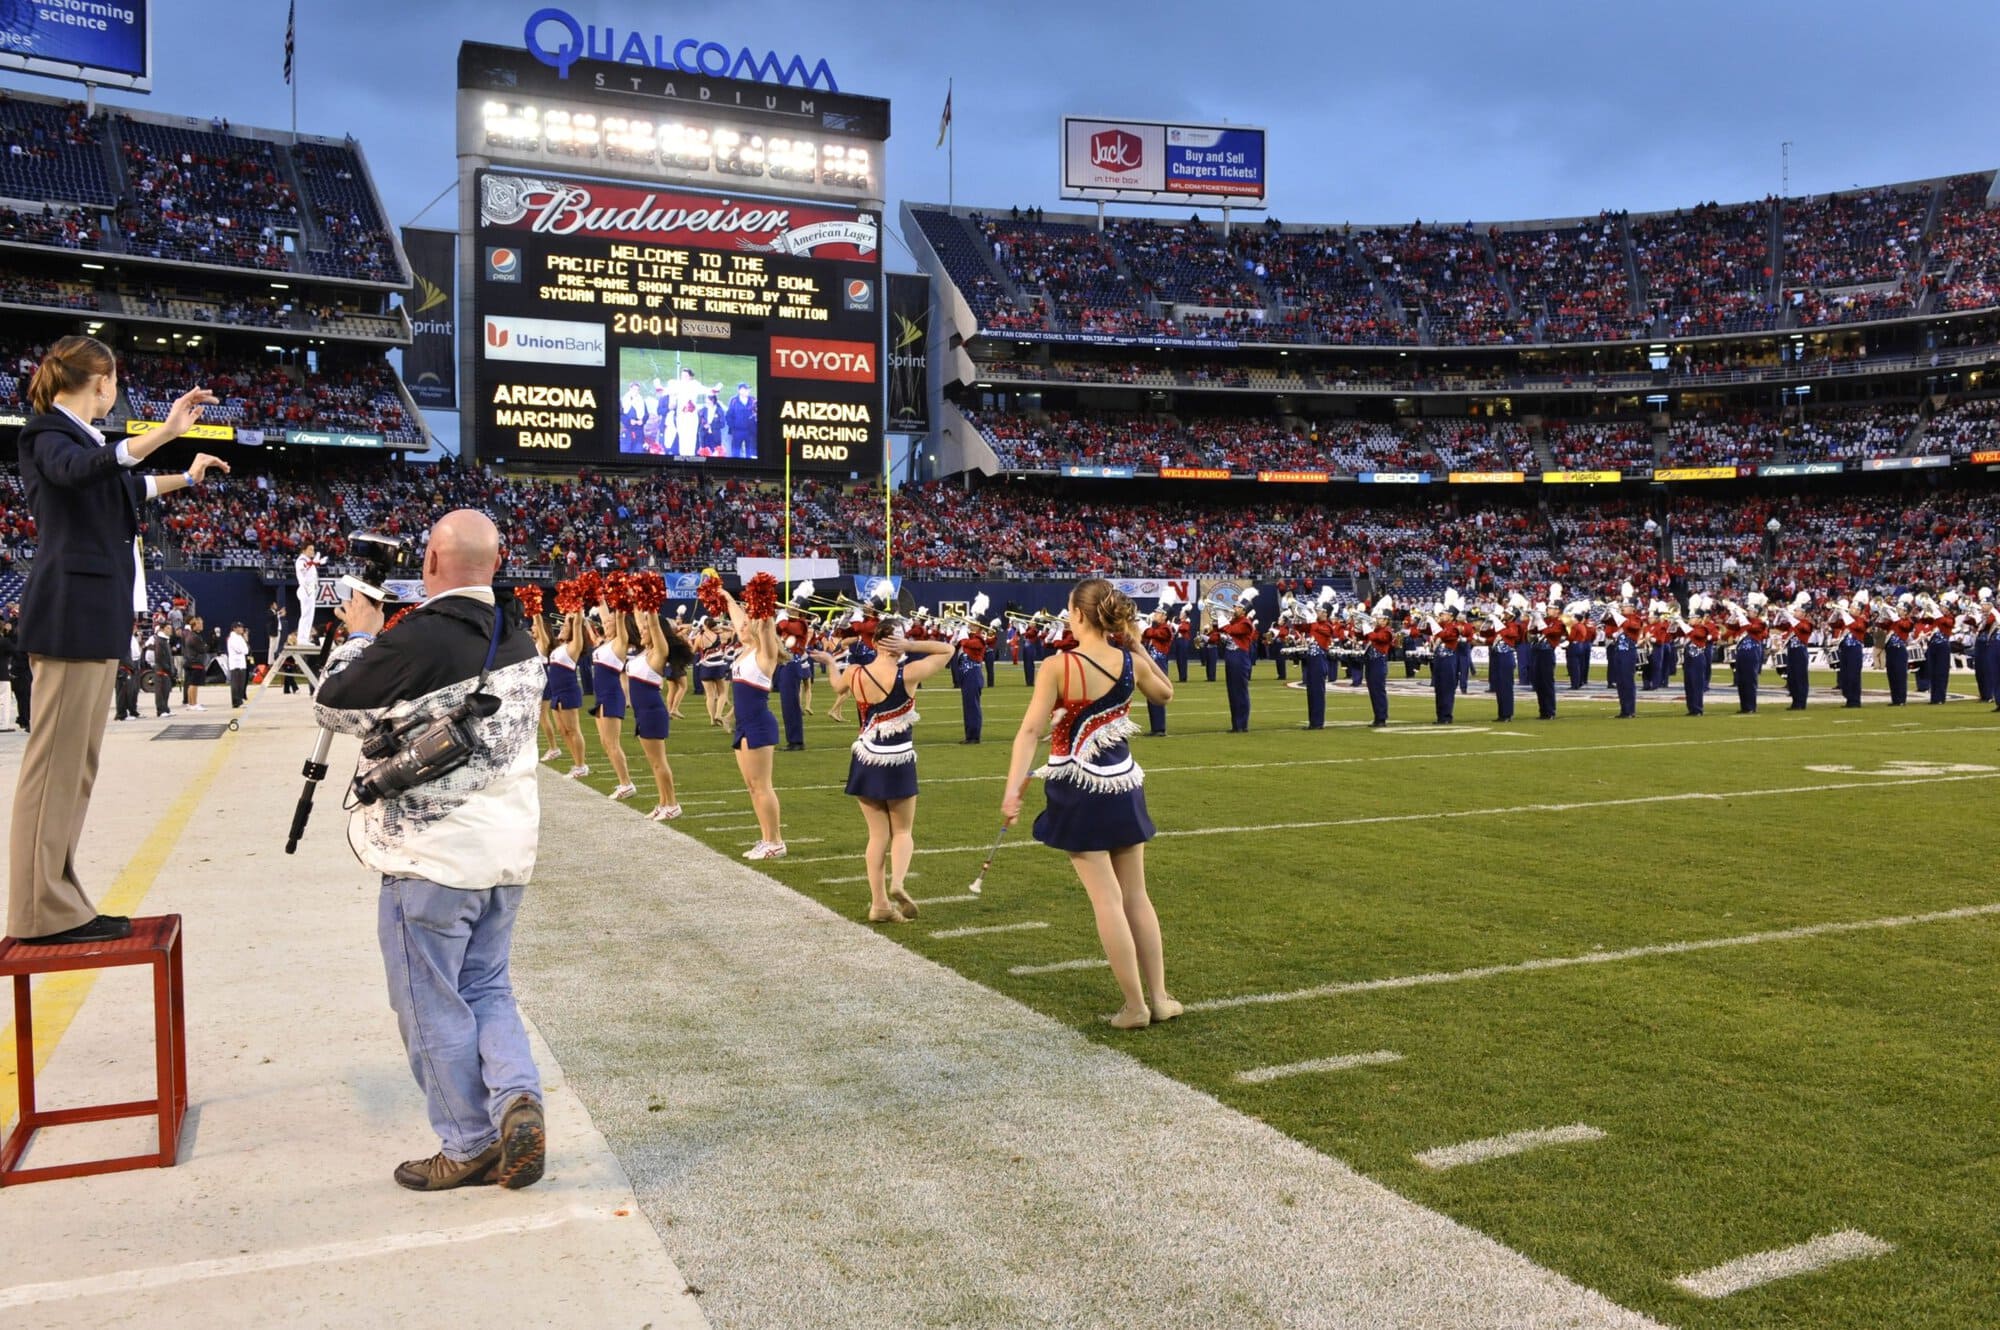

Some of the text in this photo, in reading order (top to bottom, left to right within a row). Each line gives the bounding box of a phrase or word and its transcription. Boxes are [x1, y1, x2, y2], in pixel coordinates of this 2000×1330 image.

[40, 9, 108, 31] science
[524, 7, 839, 92] QUALCOMM
[594, 72, 815, 114] STADIUM
[1092, 136, 1141, 166] Jack
[1186, 150, 1244, 164] Buy and Sell
[1095, 174, 1139, 185] in the box
[1173, 162, 1257, 179] Chargers Tickets!
[518, 188, 790, 235] Budweiser
[793, 228, 874, 248] American Lager
[611, 245, 764, 271] WELCOME TO THE
[493, 273, 515, 281] pepsi
[547, 255, 819, 292] PACIFIC LIFE HOLIDAY BOWL
[557, 274, 812, 306] PRE-GAME SHOW PRESENTED BY THE
[540, 286, 828, 321] SYCUAN BAND OF THE KUMEYAAY NATION
[409, 317, 453, 336] print
[613, 312, 677, 337] 20:04
[682, 321, 730, 336] SYCUAN
[516, 333, 603, 352] UnionBank
[775, 348, 871, 373] TOYOTA
[888, 352, 926, 369] Sprint
[493, 384, 597, 408] ARIZONA
[496, 409, 595, 430] MARCHING
[780, 401, 871, 423] ARIZONA
[302, 434, 331, 445] Degree
[349, 436, 377, 446] Degree
[518, 431, 571, 449] BAND
[782, 424, 868, 442] MARCHING
[802, 445, 848, 460] BAND
[1162, 469, 1230, 479] WELLS FARGO
[1373, 473, 1419, 483] GEICO
[1459, 472, 1514, 481] CYMER
[1771, 466, 1796, 475] Degree
[1812, 464, 1837, 473] Degree
